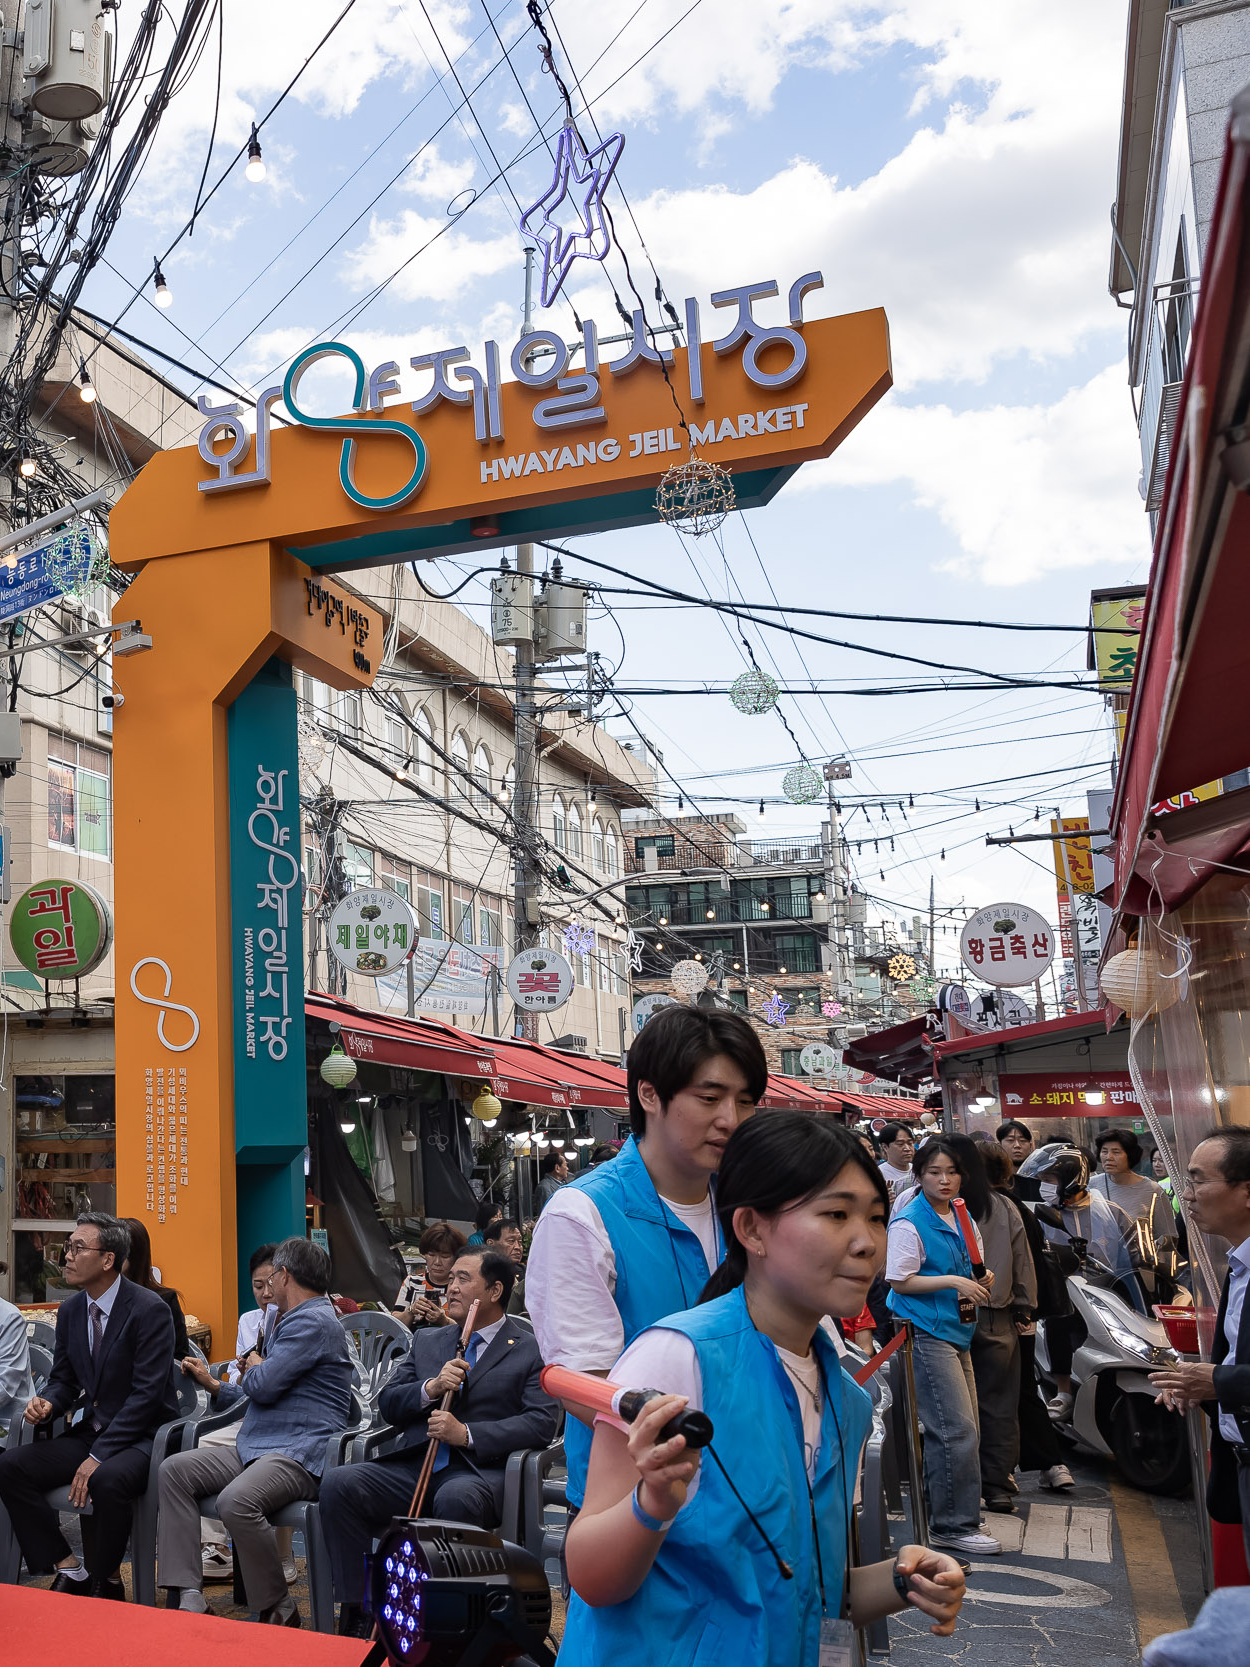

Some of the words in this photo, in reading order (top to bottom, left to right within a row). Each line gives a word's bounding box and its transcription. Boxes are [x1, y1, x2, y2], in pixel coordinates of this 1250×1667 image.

[197, 270, 824, 511] 화양제일시장
[480, 436, 621, 484] HWAYANG
[629, 422, 683, 457] JEIL
[691, 402, 810, 448] MARKET
[0, 573, 50, 602] Neungdong-ro
[1059, 883, 1095, 892] 46-02
[248, 764, 298, 1062] 화양제일시장
[345, 893, 395, 911] 화양제일시장
[27, 885, 80, 970] 과일
[976, 908, 1029, 927] 화양제일시장
[336, 922, 408, 950] 제일야채
[244, 927, 254, 988] HWAYANG
[519, 950, 557, 964] 화양제일시장
[967, 932, 1049, 965] 황금축산
[517, 972, 561, 993] 꽃
[246, 989, 254, 1010] JEIL
[524, 995, 557, 1005] 한아름
[246, 1011, 256, 1059] MARKET
[1110, 1090, 1139, 1105] 판매
[960, 1303, 974, 1313] STAFF
